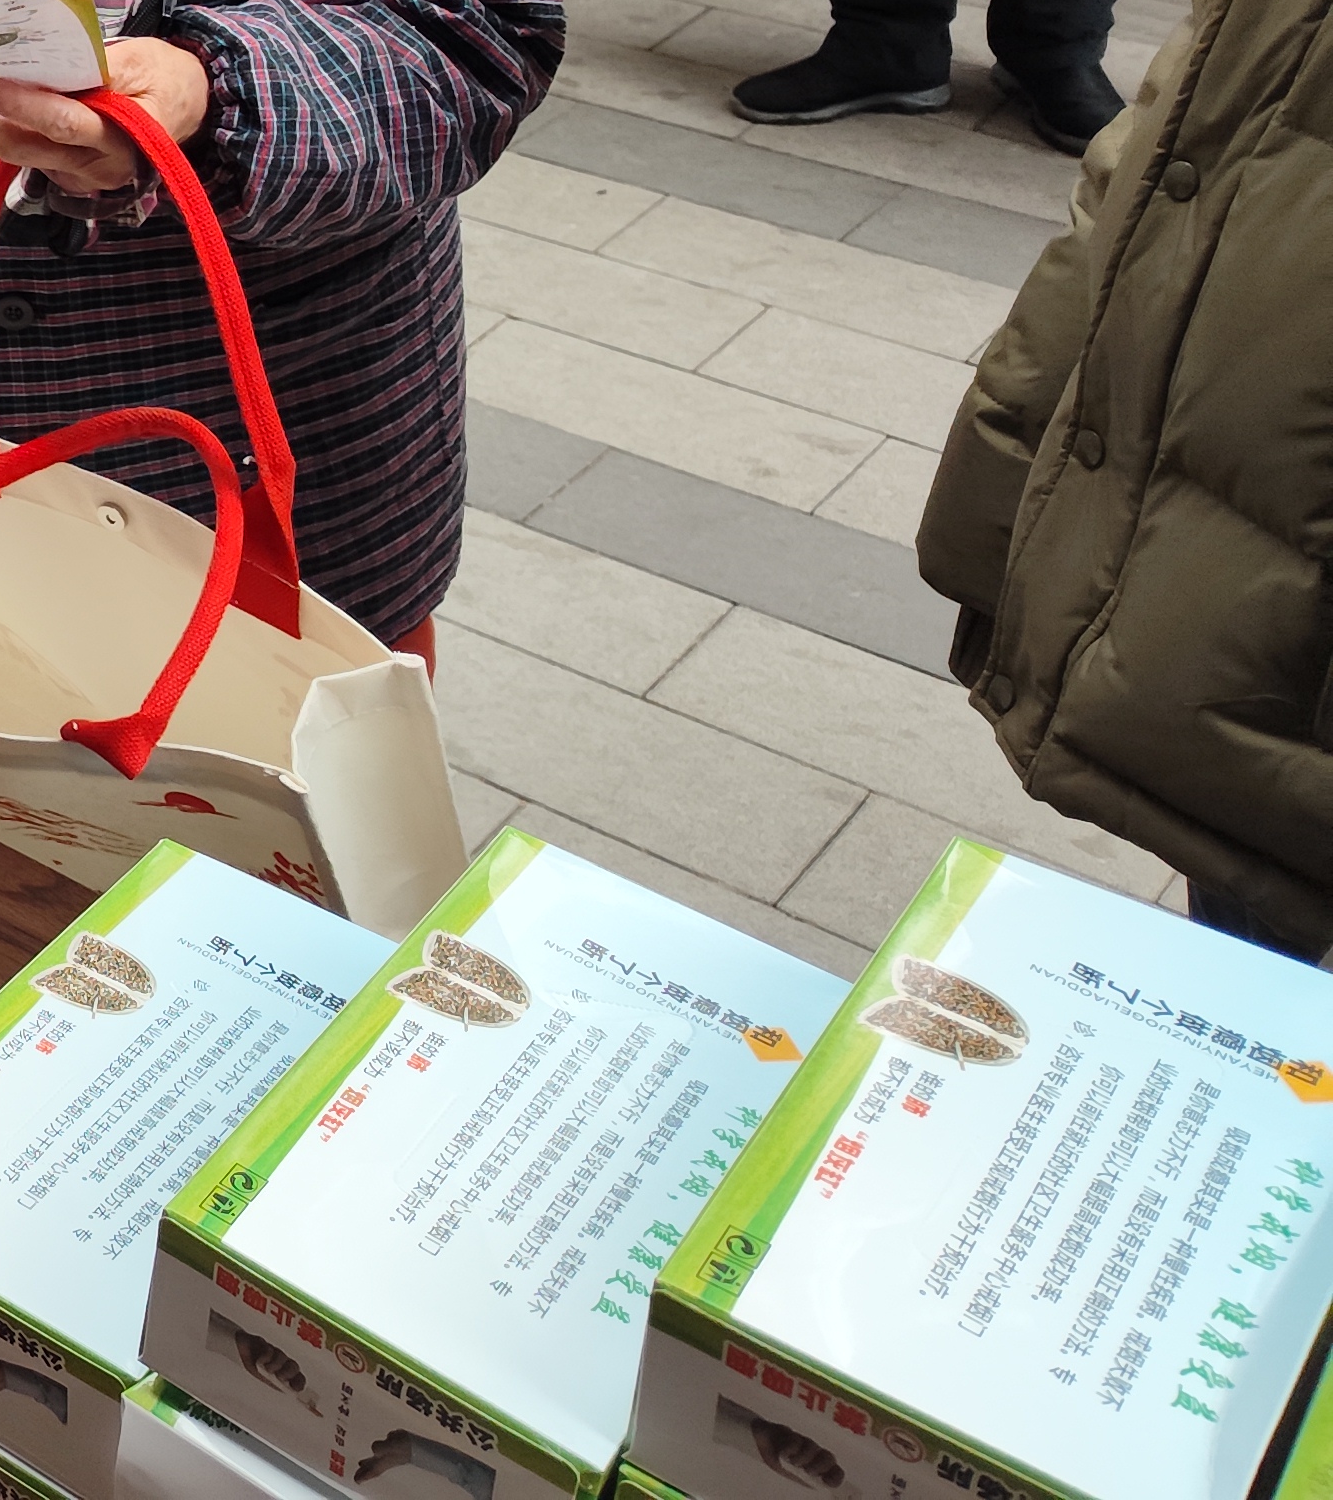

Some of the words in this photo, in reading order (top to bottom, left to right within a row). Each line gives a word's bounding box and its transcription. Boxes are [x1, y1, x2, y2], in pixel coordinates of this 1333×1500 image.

[205, 933, 346, 1014] 烟瘾做个了断
[542, 939, 742, 1044] HEYANYINZUOGELIAODUAN
[575, 936, 782, 1050] 和烟瘾做个了断
[33, 1017, 75, 1057] 谁的肺
[361, 1017, 422, 1082] 都不该成为
[403, 1029, 448, 1074] 谁的肺
[1028, 963, 1279, 1082] HEYANYINZUOGELIAODUAN
[1065, 961, 1324, 1086] 和烟瘾做个了断
[852, 1054, 912, 1127] 都不该成为
[899, 1068, 945, 1119] 谁的肺
[210, 1262, 325, 1349] 禁止吸烟
[372, 1366, 497, 1454] 公共场所
[719, 1341, 873, 1437] 禁止吸烟
